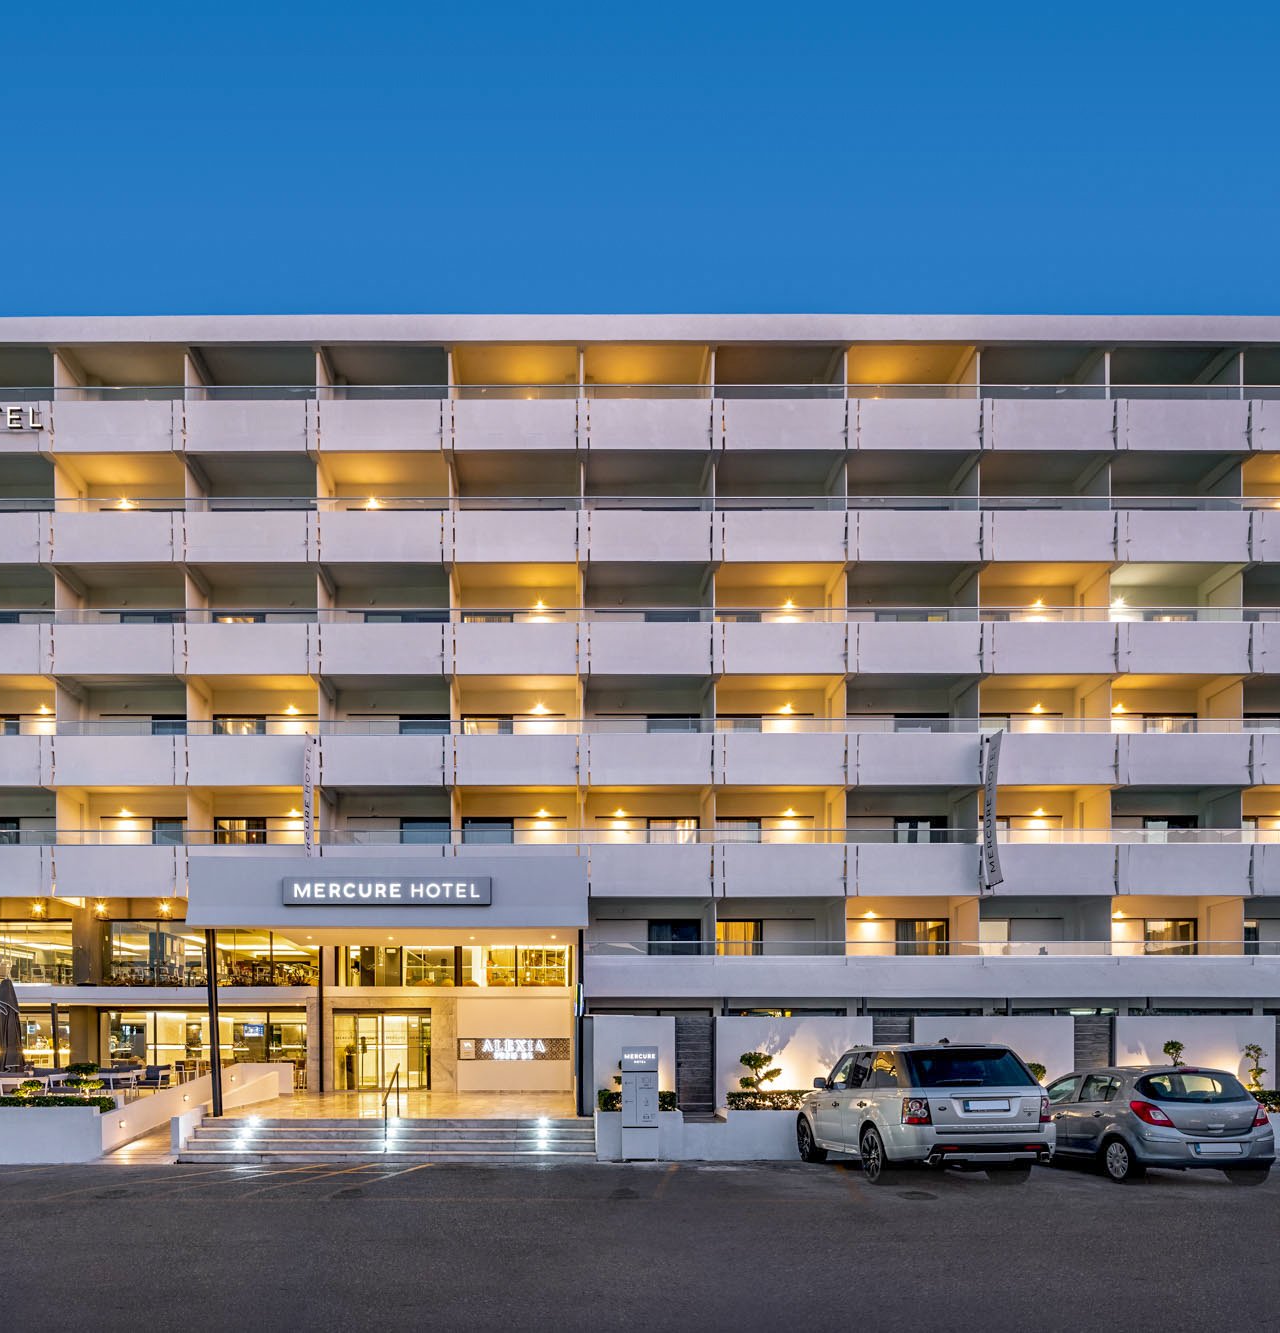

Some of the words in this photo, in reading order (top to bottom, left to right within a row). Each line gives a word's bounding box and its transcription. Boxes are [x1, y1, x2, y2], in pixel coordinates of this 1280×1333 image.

[304, 747, 312, 794] HOTEL
[987, 744, 998, 792] HOTEL
[304, 801, 312, 858] ERCURE
[985, 798, 996, 873] MERCURE
[293, 883, 402, 898] MERCURE
[410, 883, 481, 898] HOTEL
[482, 1039, 545, 1053] ALEXIA
